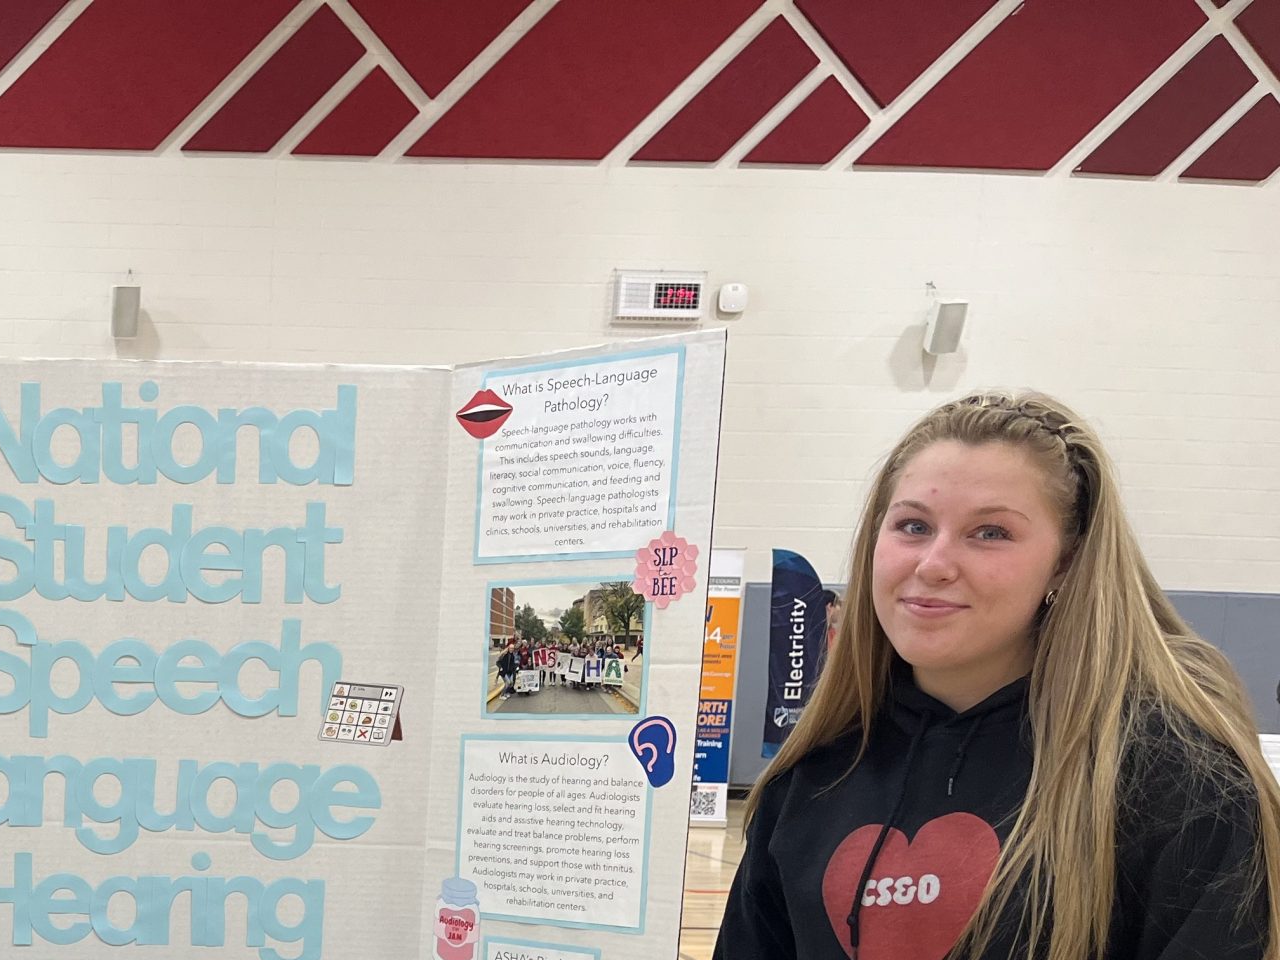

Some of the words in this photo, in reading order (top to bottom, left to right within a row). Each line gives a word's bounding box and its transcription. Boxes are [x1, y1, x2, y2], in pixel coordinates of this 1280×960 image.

[501, 382, 532, 396] What
[535, 380, 543, 392] is
[547, 368, 657, 393] Speech-Language
[544, 393, 609, 413] Pathology?
[501, 424, 568, 439] Speech-language
[570, 418, 611, 432] pathology
[613, 414, 637, 425] works
[639, 412, 657, 422] with
[653, 547, 678, 567] SLP
[651, 577, 678, 597] BEE
[784, 597, 808, 701] Electricity
[498, 751, 527, 764] What
[530, 752, 538, 764] is
[540, 752, 609, 769] Audiology?
[440, 916, 474, 931] Audiology
[448, 932, 462, 940] JAM
